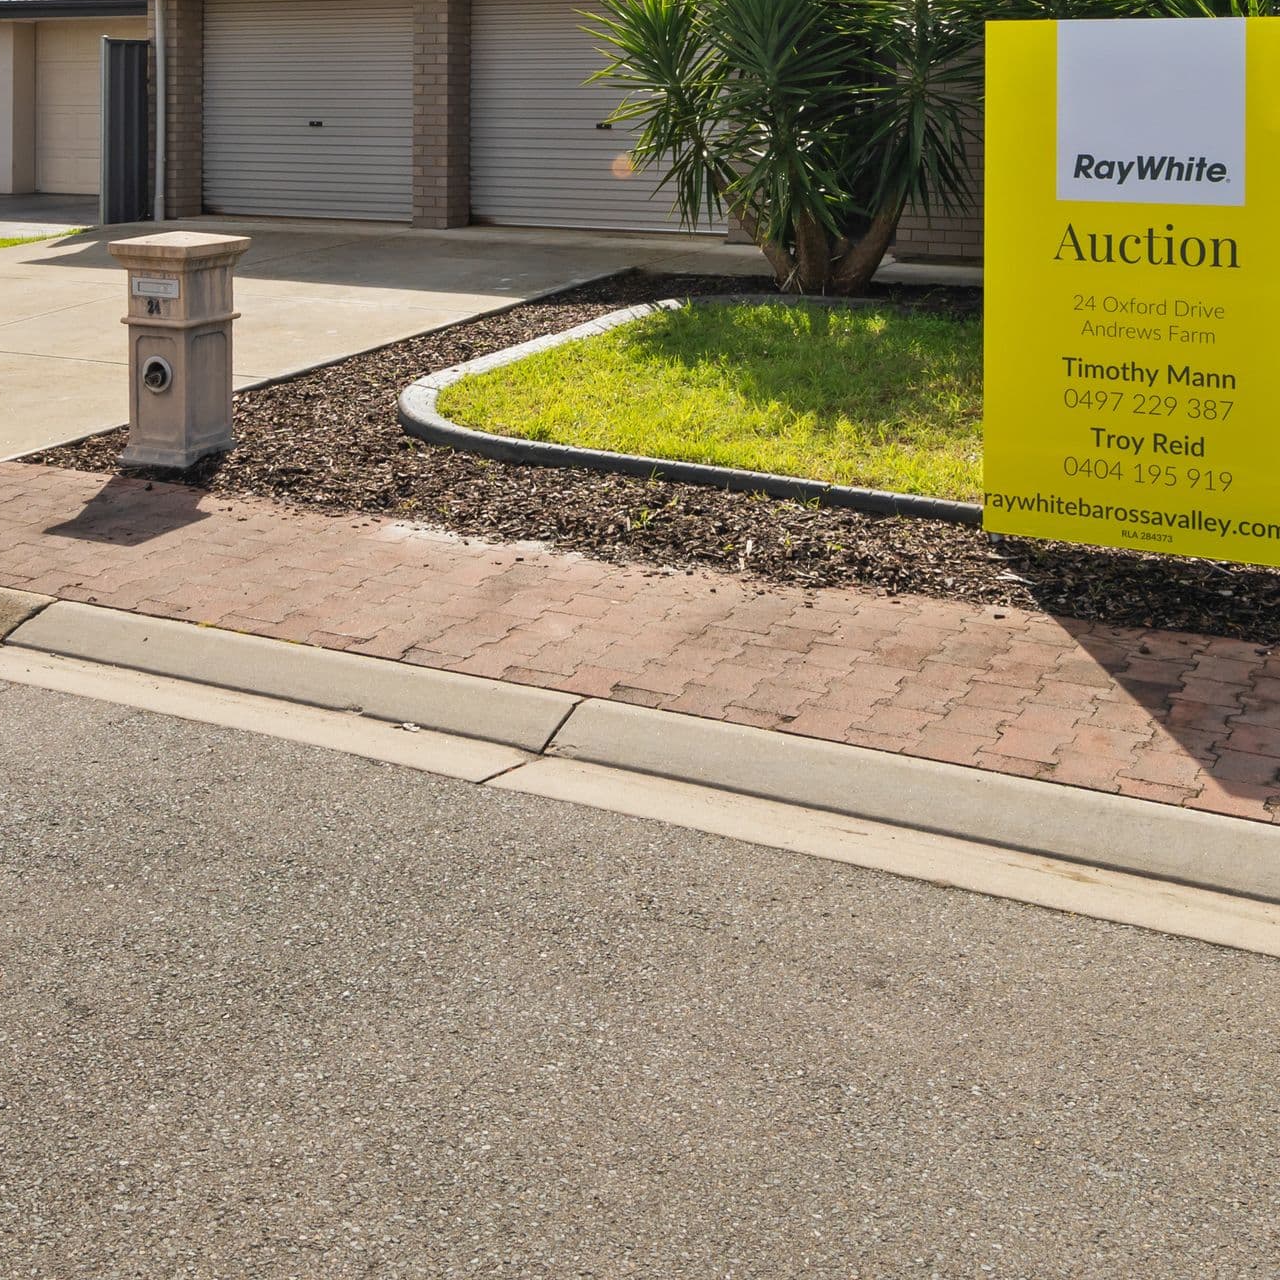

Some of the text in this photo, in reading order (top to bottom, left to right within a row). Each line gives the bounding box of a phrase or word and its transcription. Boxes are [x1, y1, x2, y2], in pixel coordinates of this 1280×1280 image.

[1053, 223, 1241, 269] Auction
[1073, 294, 1225, 320] 24 Oxford Drive
[1081, 320, 1216, 344] Andrews Farm
[1062, 356, 1236, 389] Timothy Mann
[1064, 388, 1234, 422] 0497 229 387
[1091, 427, 1204, 458] Troy Reid
[1064, 456, 1233, 493] 0404 195 919
[1121, 530, 1174, 543] RLA 284373
